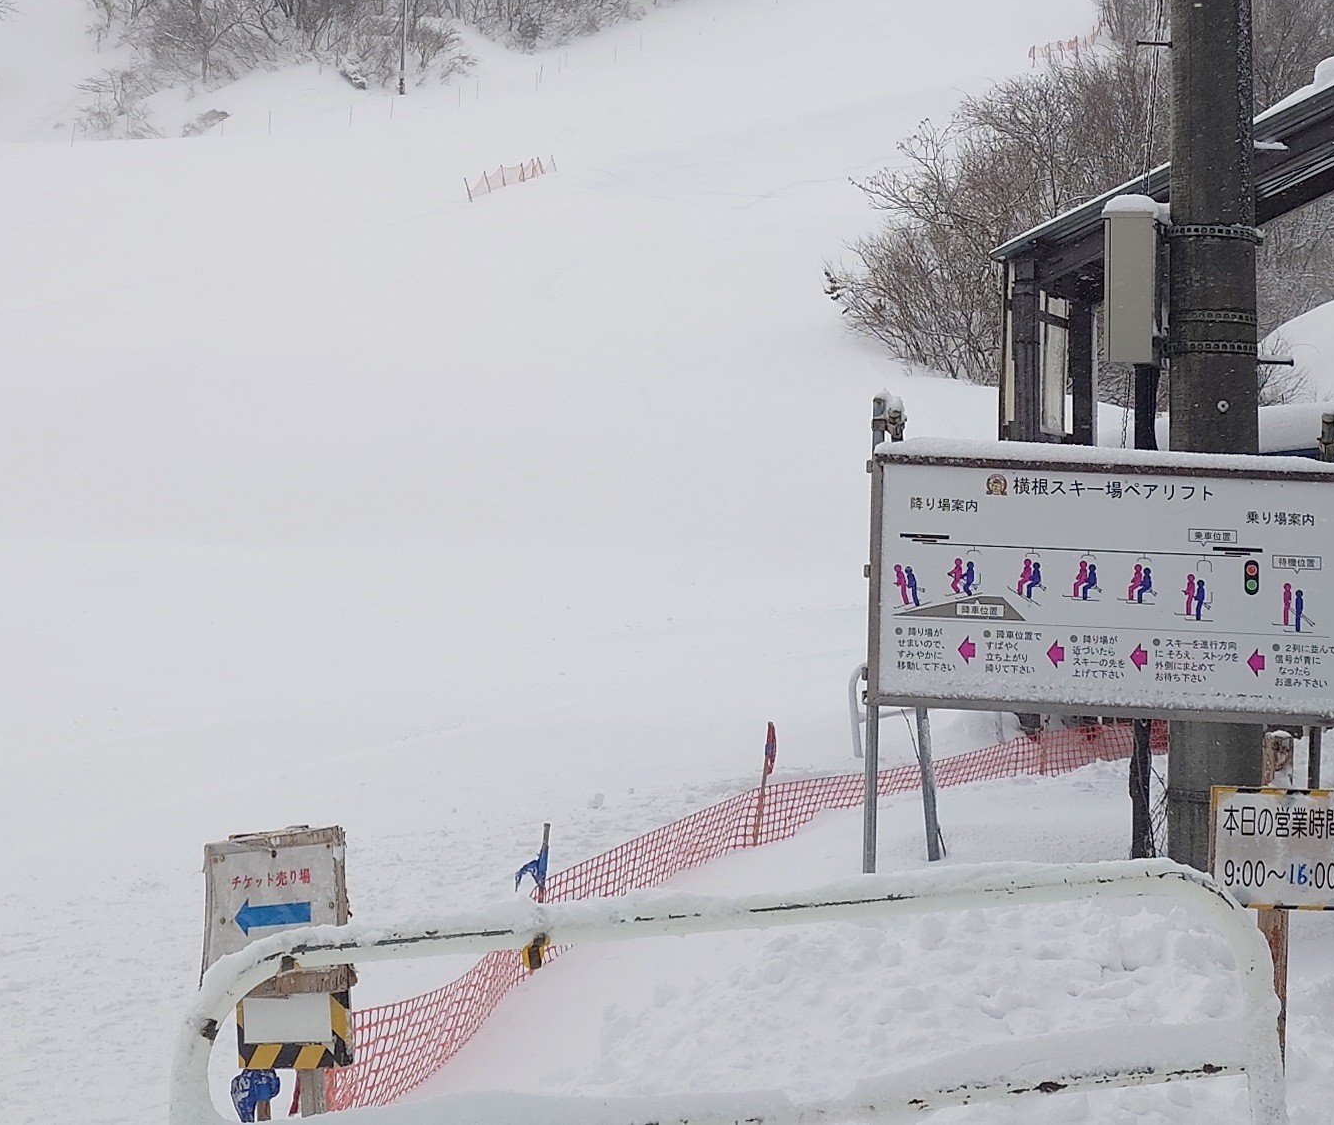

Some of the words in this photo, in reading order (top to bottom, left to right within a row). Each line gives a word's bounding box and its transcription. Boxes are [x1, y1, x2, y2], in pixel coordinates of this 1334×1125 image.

[1012, 476, 1214, 502] 横根スキー場ペアリフト
[909, 496, 979, 513] 降り場案内
[1245, 510, 1316, 527] 乗り場案内
[1194, 531, 1232, 542] 乗車位置
[1278, 557, 1316, 568] 待機位置
[961, 605, 999, 616] 降車位置
[907, 627, 943, 638] 降り場が
[996, 629, 1042, 641] 降車位置で
[898, 639, 946, 650] せまいので、
[1082, 634, 1118, 645] 降り場が
[1165, 638, 1238, 651] スキーを進行方向
[985, 641, 1019, 651] すばやく
[1072, 645, 1116, 657] 近づいたら
[897, 650, 943, 661] すみやかに
[985, 652, 1028, 663] 立ち上がり
[1274, 654, 1322, 665] 信号が青に
[897, 661, 956, 673] 移動して下さい
[1072, 657, 1126, 669] スキーの先を
[1155, 661, 1216, 673] 外側にまとめて
[985, 664, 1035, 674] 降りて下さい
[1072, 669, 1125, 680] 上げて下さい
[1278, 666, 1311, 676] なったら
[1155, 672, 1207, 683] お待ち下さい
[1274, 677, 1328, 688] お進み下さい
[230, 867, 311, 890] チケット売り場
